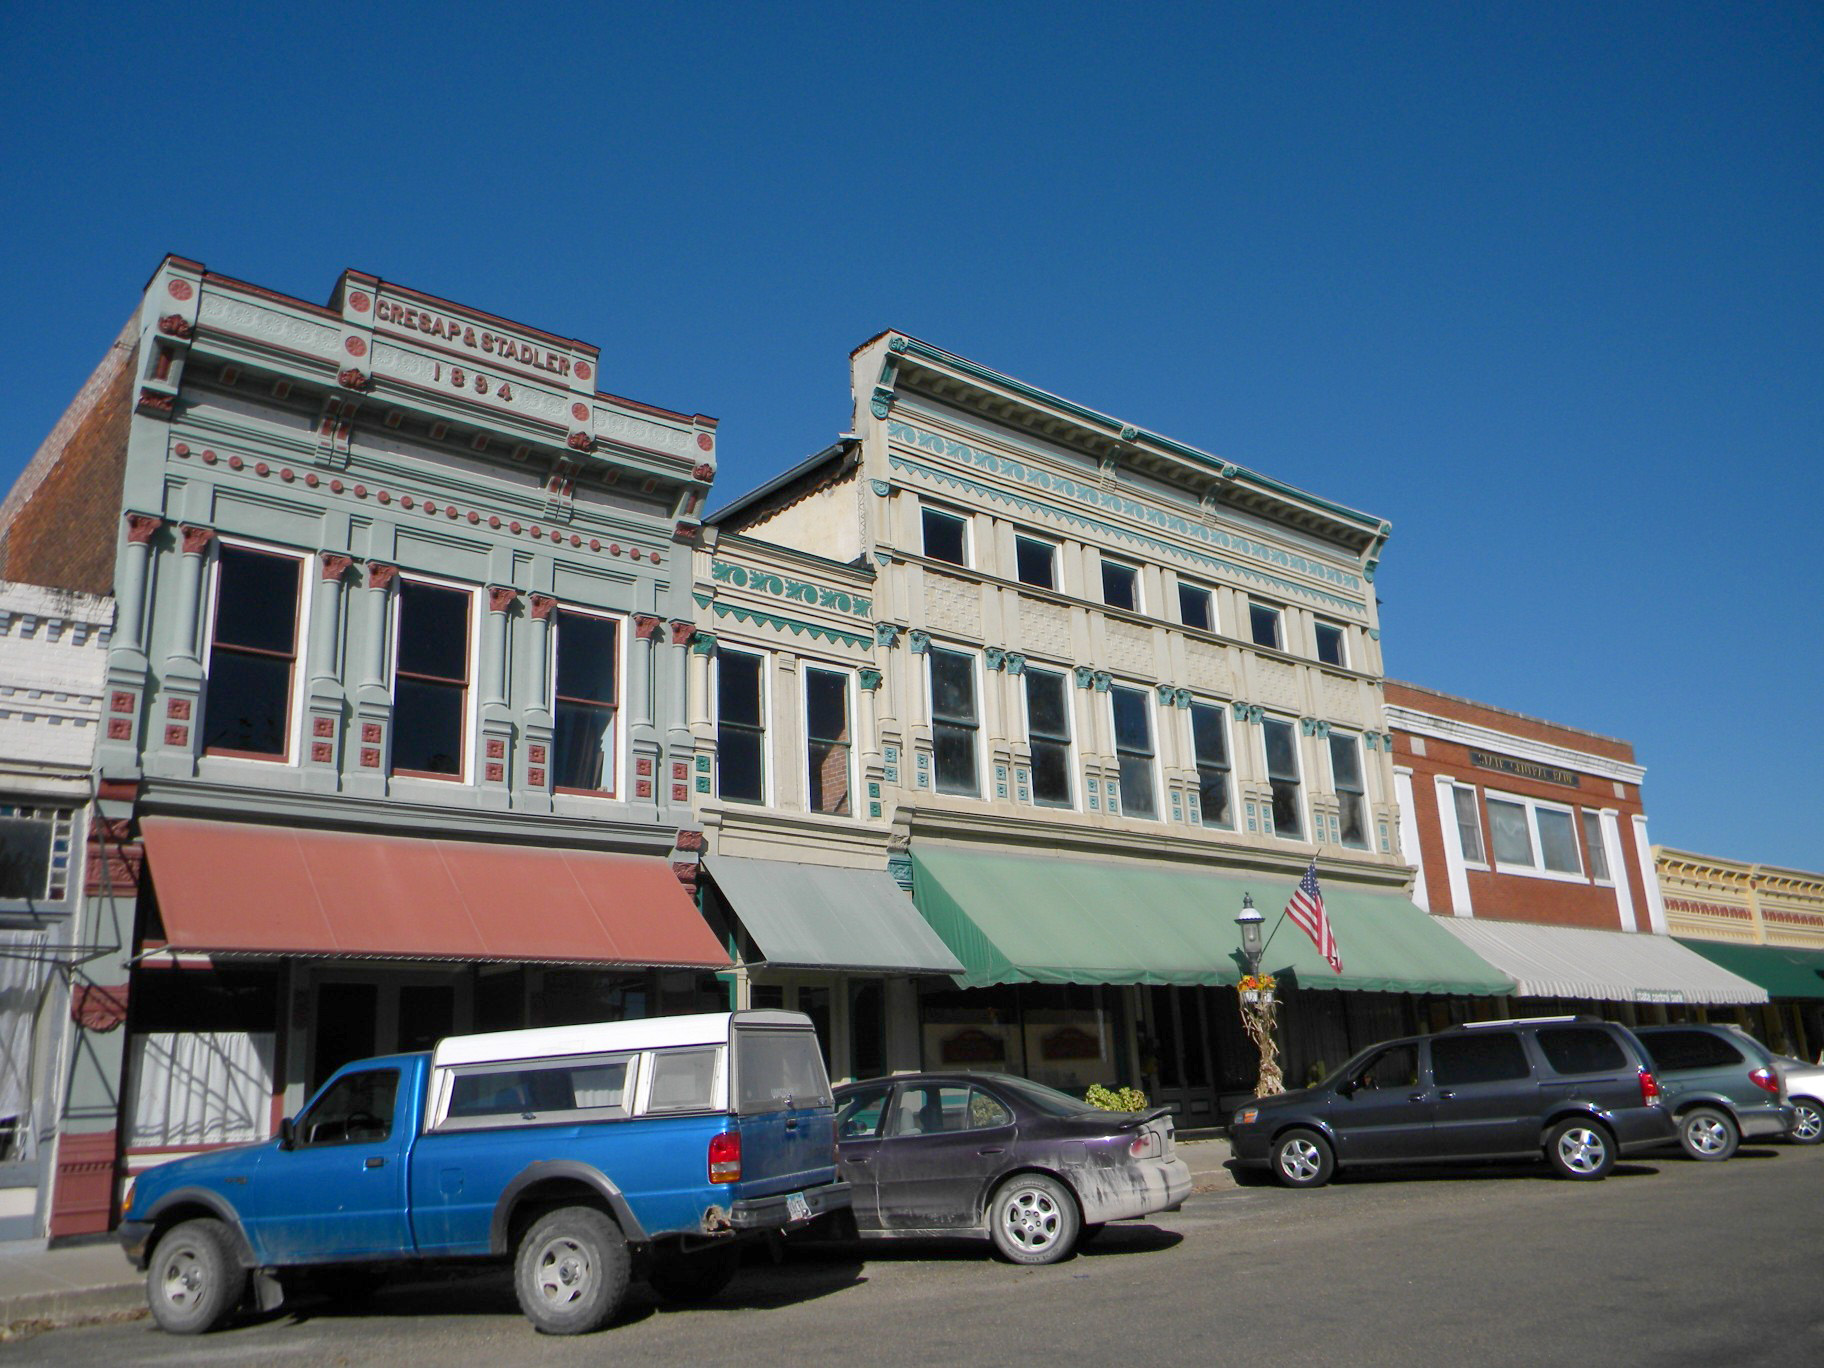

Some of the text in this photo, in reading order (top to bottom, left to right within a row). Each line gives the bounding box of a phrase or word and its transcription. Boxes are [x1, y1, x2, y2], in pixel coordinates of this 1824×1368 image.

[375, 298, 571, 377] CRESAP & STADLER
[433, 362, 513, 402] 1894
